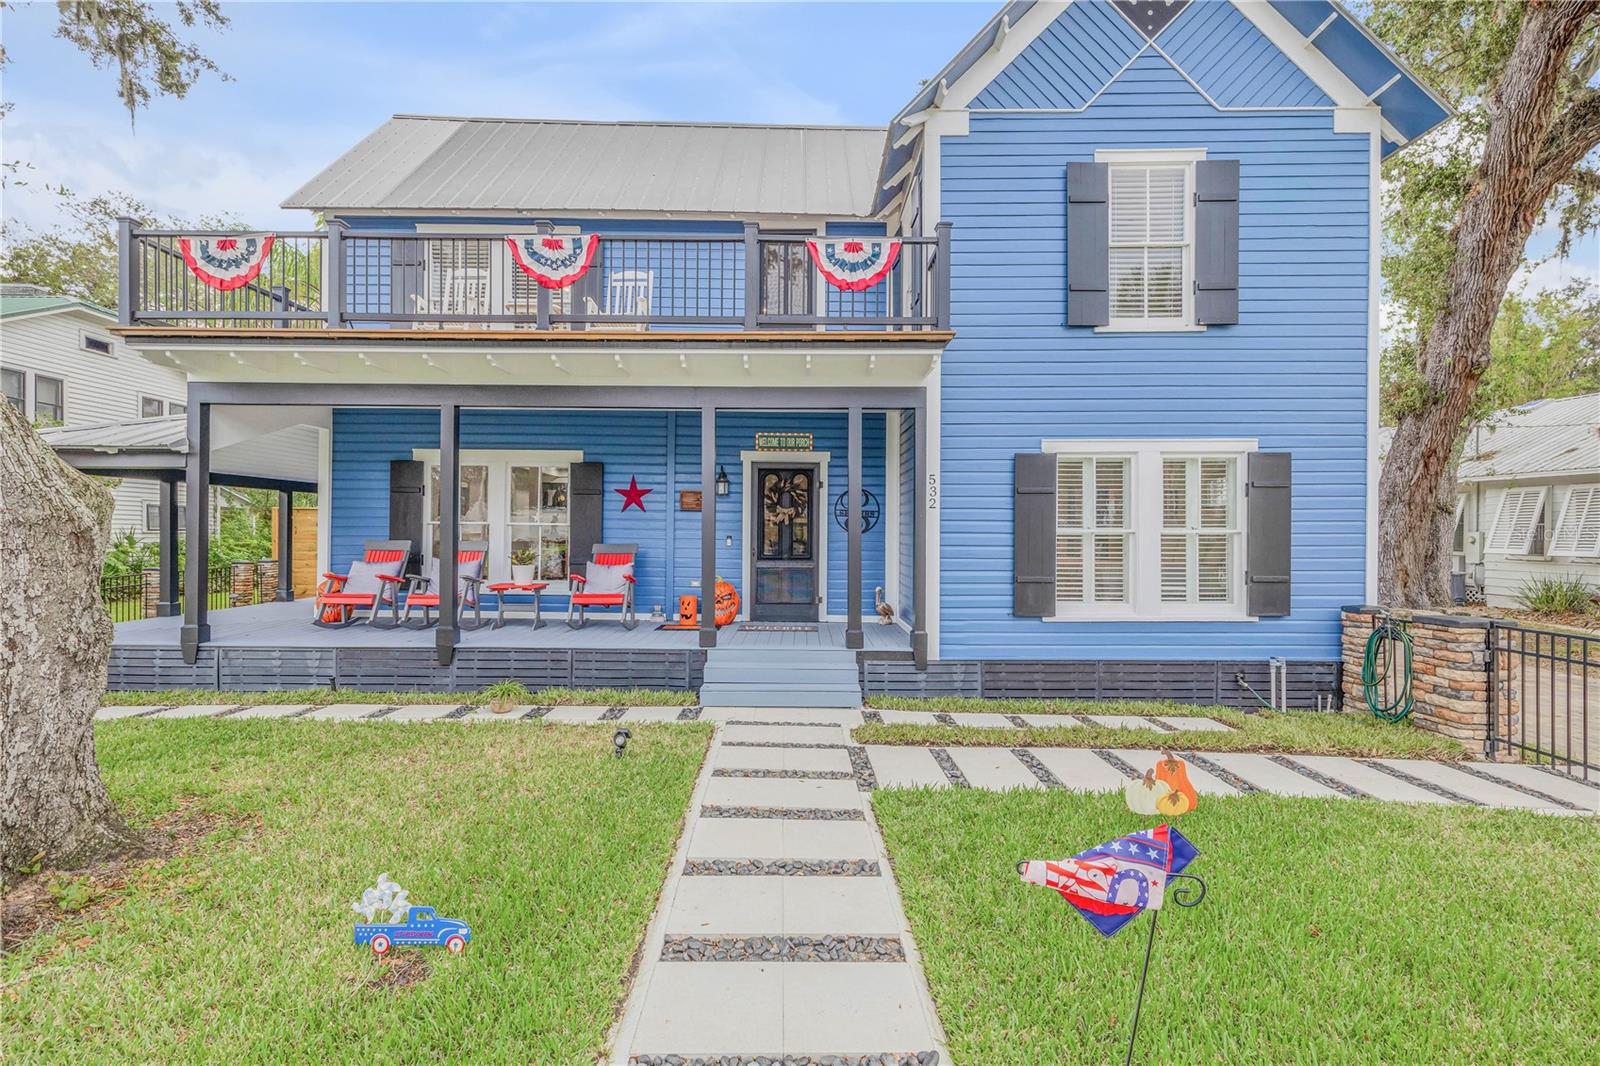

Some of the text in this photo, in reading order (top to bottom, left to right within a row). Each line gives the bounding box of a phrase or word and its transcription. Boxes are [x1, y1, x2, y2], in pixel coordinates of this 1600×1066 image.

[759, 437, 810, 447] WELCOME TO OUR PORCH
[929, 474, 937, 509] 532
